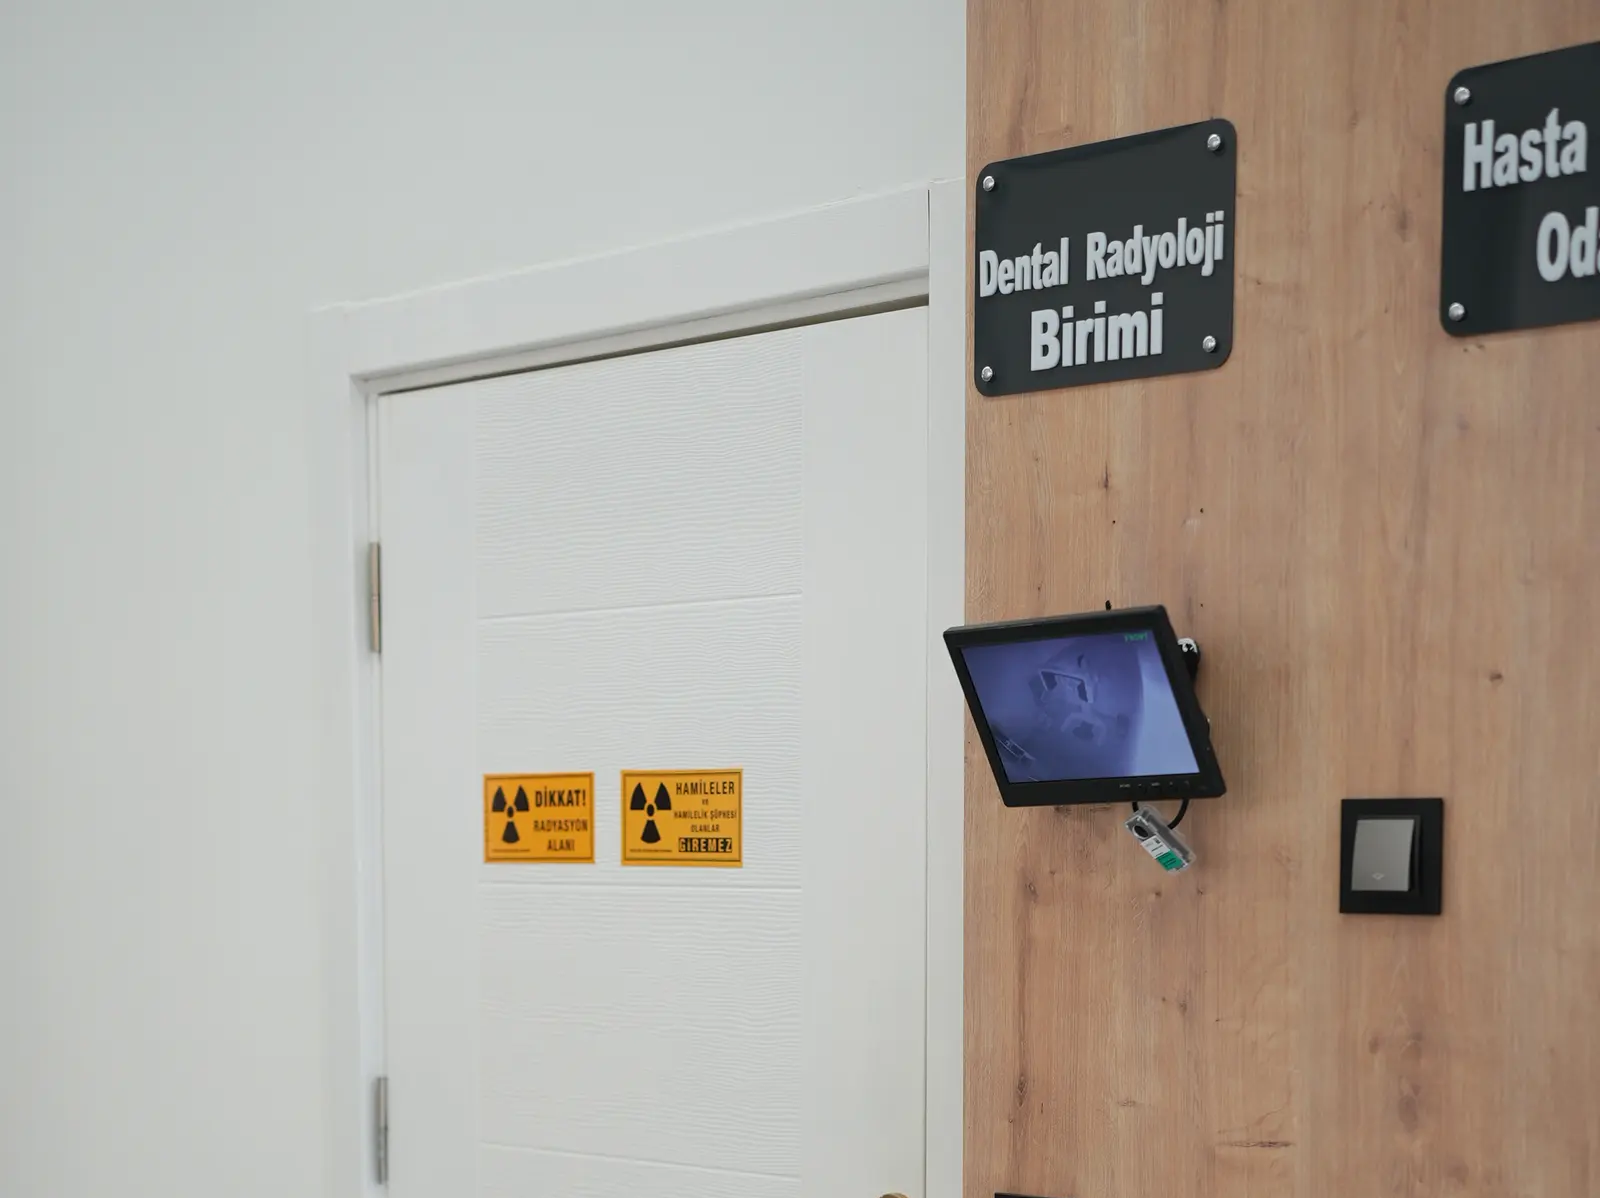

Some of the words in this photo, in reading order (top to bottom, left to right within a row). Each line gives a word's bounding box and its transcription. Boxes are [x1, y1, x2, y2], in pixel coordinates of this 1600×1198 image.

[1462, 107, 1588, 192] Hasta
[1536, 205, 1600, 283] Od
[979, 236, 1070, 298] Dental
[1086, 210, 1225, 286] Radyoloji
[1030, 291, 1164, 372] Birimi
[535, 785, 586, 807] DİKKAT!
[675, 779, 735, 795] HAMİLELER
[533, 818, 588, 832] RADYASYON
[691, 824, 720, 832] OLANLAR
[547, 839, 575, 851] ALANI
[679, 838, 732, 852] GİREMEZ
